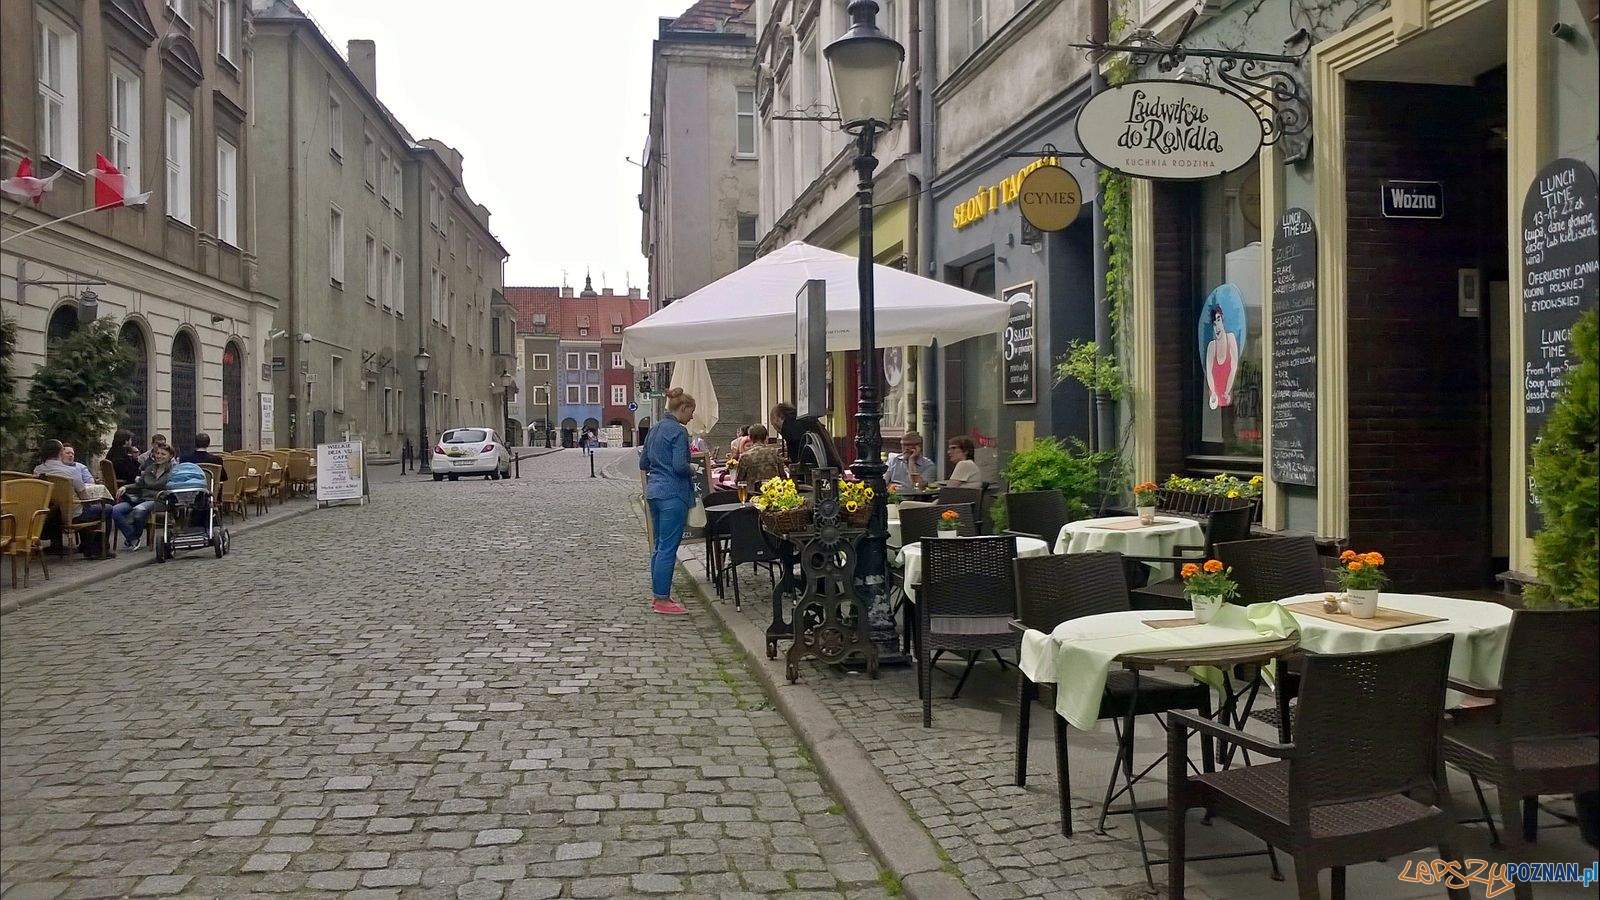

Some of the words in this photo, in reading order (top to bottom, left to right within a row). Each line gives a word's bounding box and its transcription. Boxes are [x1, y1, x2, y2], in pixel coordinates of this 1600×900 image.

[1124, 89, 1209, 127] Ludwiku
[1117, 124, 1143, 149] do
[1125, 158, 1167, 167] KUCHNIA
[1172, 159, 1215, 168] RODZIMA
[1540, 168, 1575, 195] LUNCH
[1023, 192, 1076, 205] CYMES
[1542, 185, 1575, 209] TIME
[1282, 211, 1301, 226] LUNCH
[1548, 218, 1566, 233] danie
[1283, 223, 1300, 238] TIME
[1525, 240, 1545, 254] deser
[1546, 235, 1559, 248] lub
[1528, 266, 1571, 286] OFERUJEMY
[1575, 260, 1600, 276] DANIA
[1549, 277, 1585, 294] POLSKIEJ
[1005, 326, 1014, 360] 3
[1541, 329, 1573, 345] LUNCH
[1540, 345, 1566, 359] TIME
[1526, 361, 1544, 376] from
